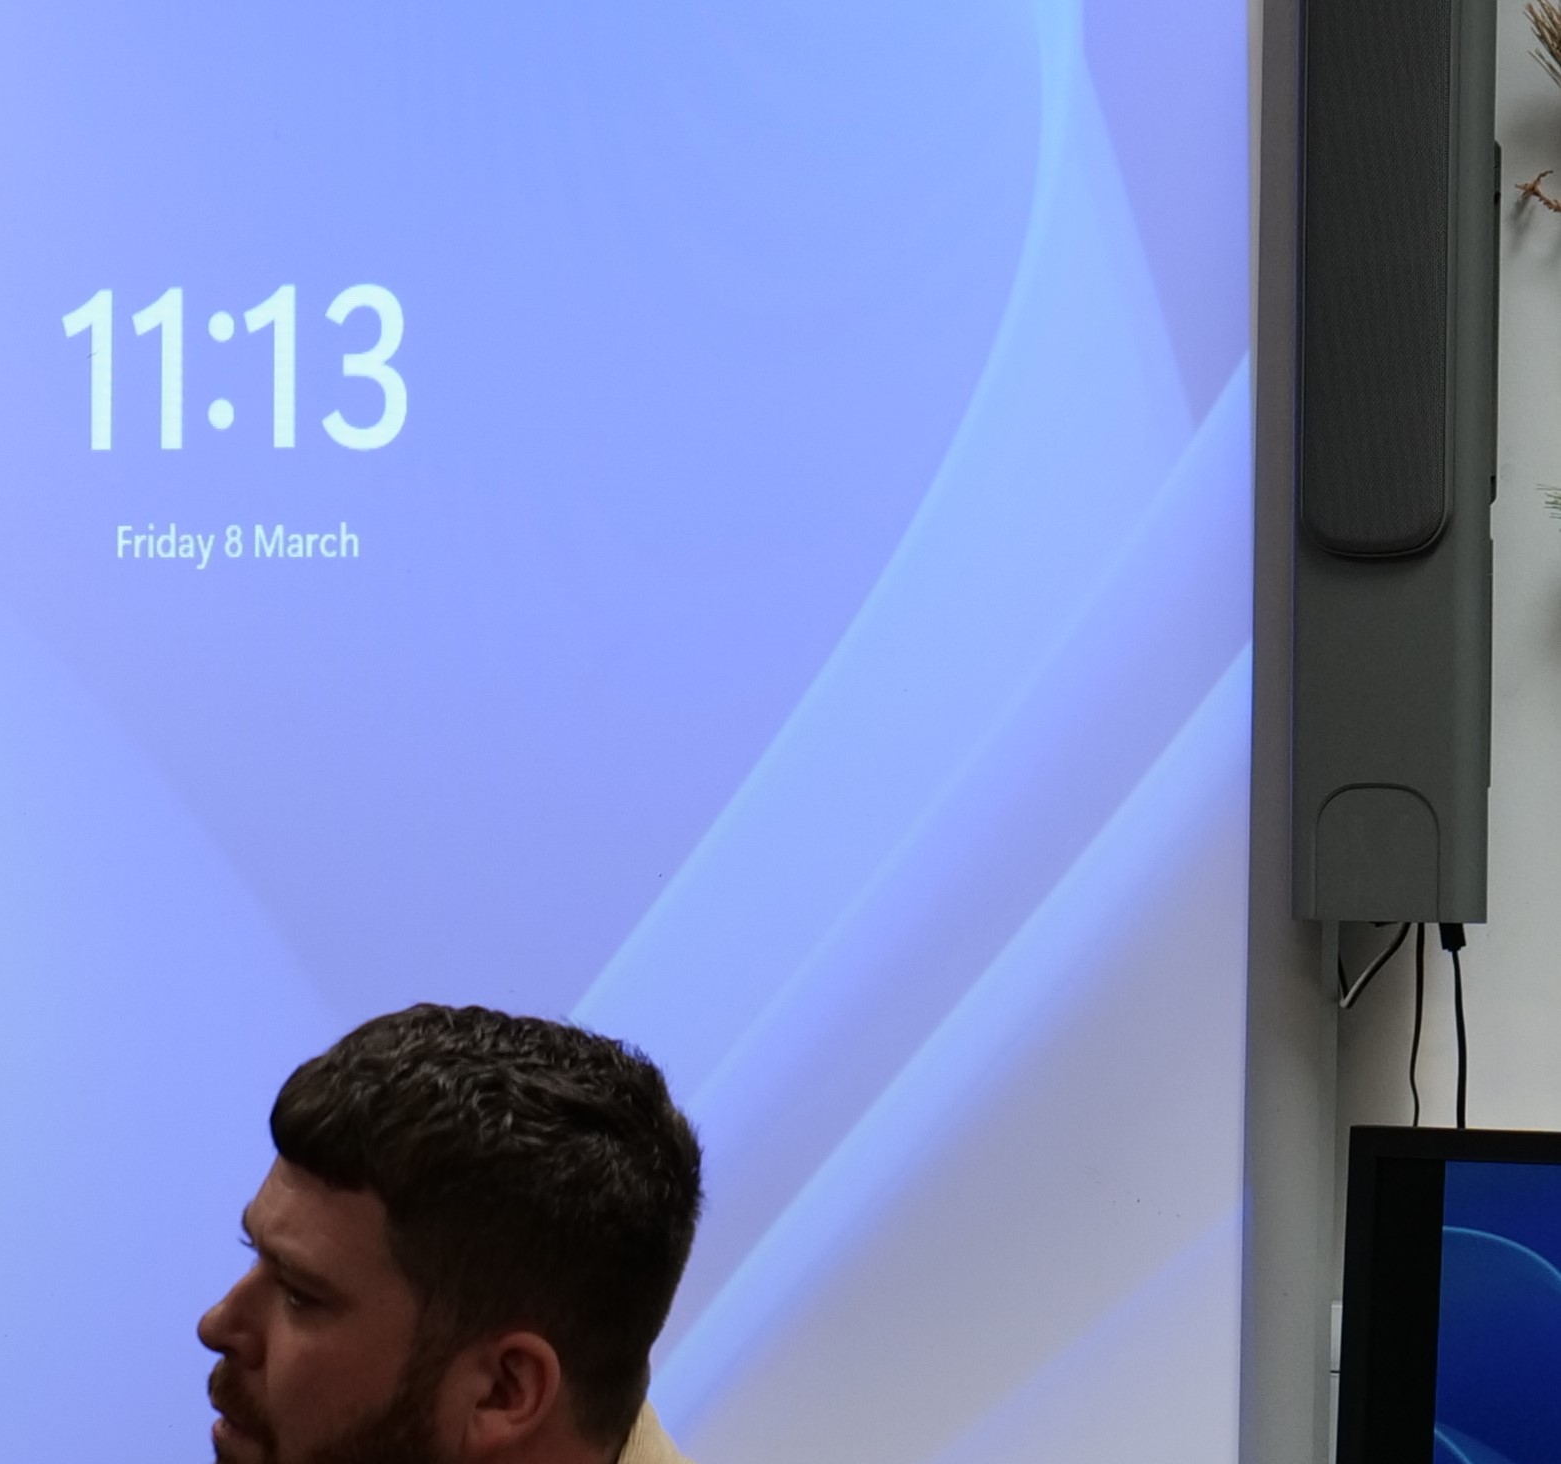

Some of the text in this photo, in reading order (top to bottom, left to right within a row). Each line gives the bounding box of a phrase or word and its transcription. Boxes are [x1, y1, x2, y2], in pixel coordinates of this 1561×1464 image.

[62, 284, 408, 451] 11:13
[116, 522, 359, 569] Friday 8 March
